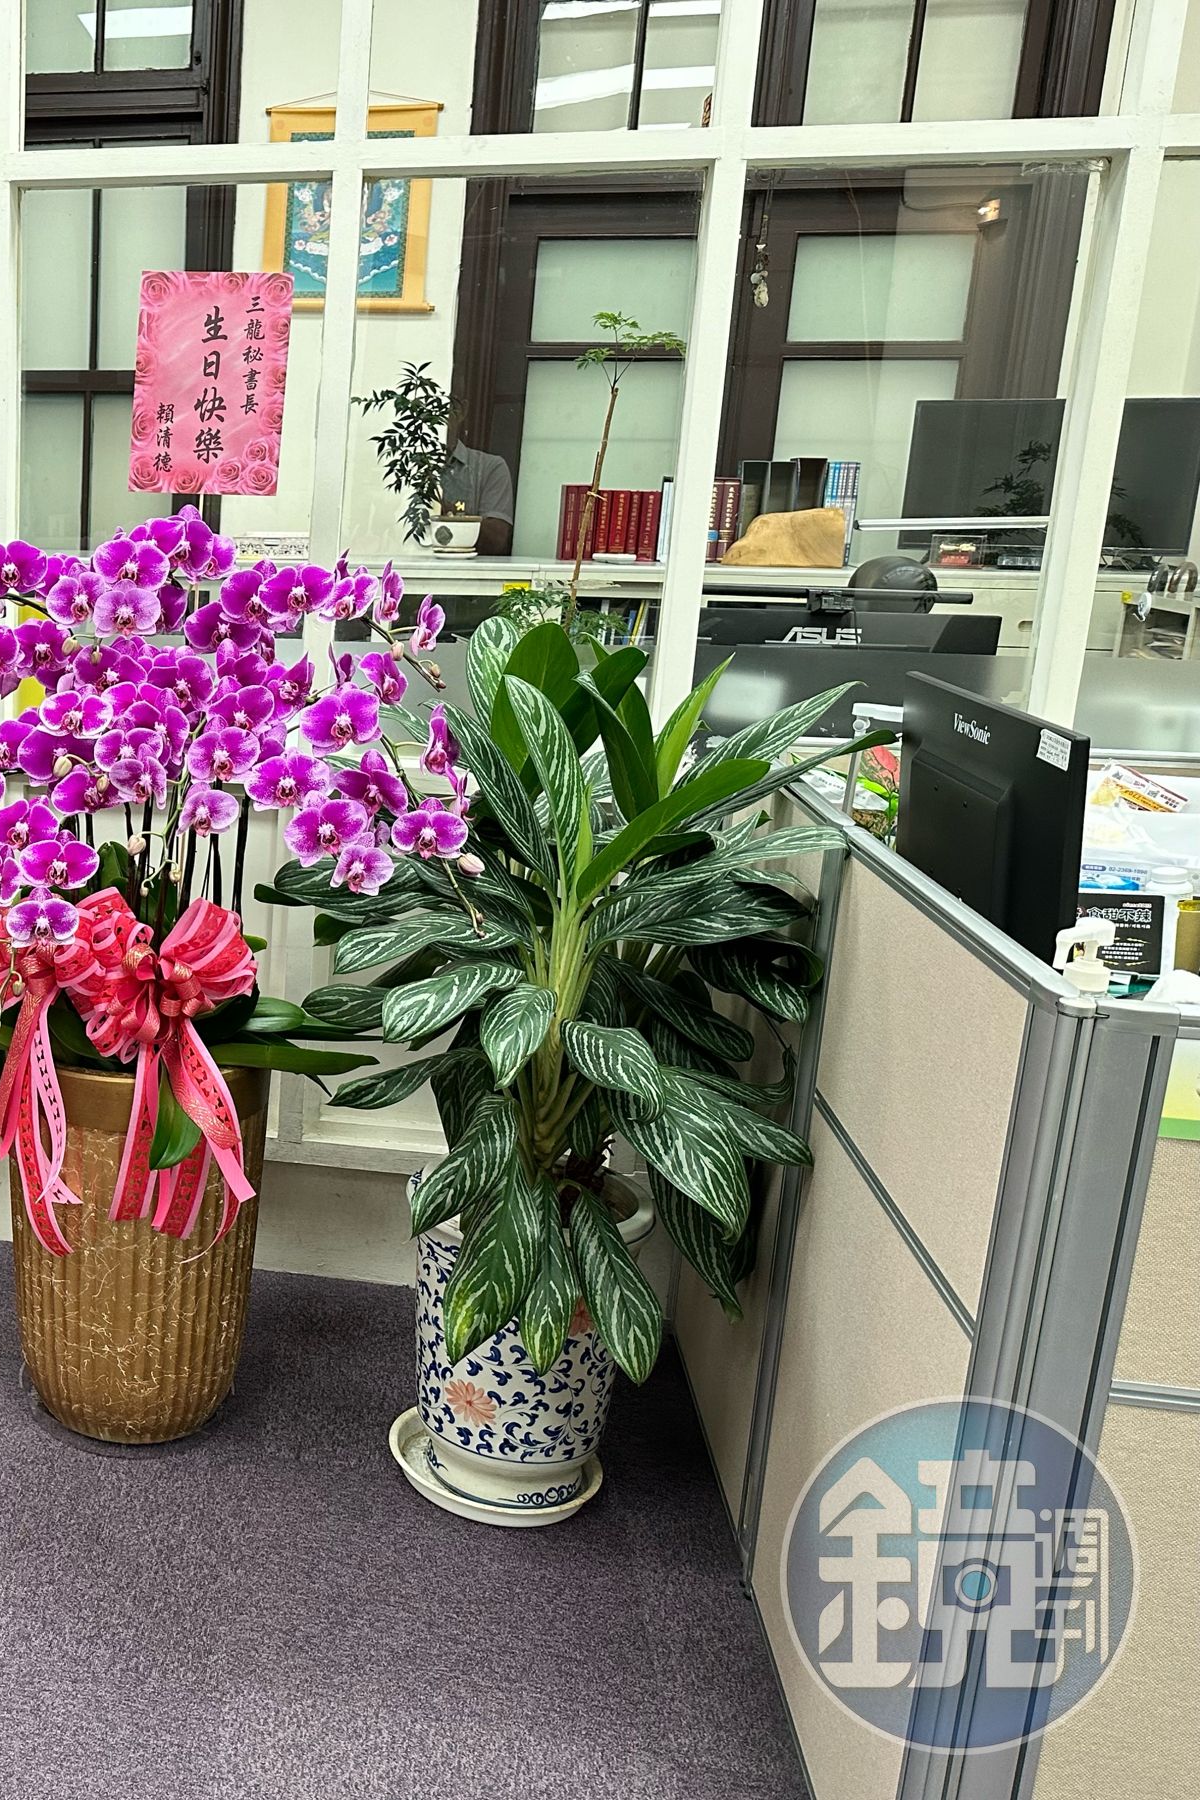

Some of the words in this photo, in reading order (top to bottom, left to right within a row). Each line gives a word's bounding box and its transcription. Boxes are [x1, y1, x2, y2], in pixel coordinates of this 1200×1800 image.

[193, 305, 228, 464] 生日快樂
[240, 295, 265, 415] 三龍秘書長
[152, 402, 174, 473] 賴清德
[765, 626, 862, 645] ASUS
[953, 712, 990, 745] ViewSonic
